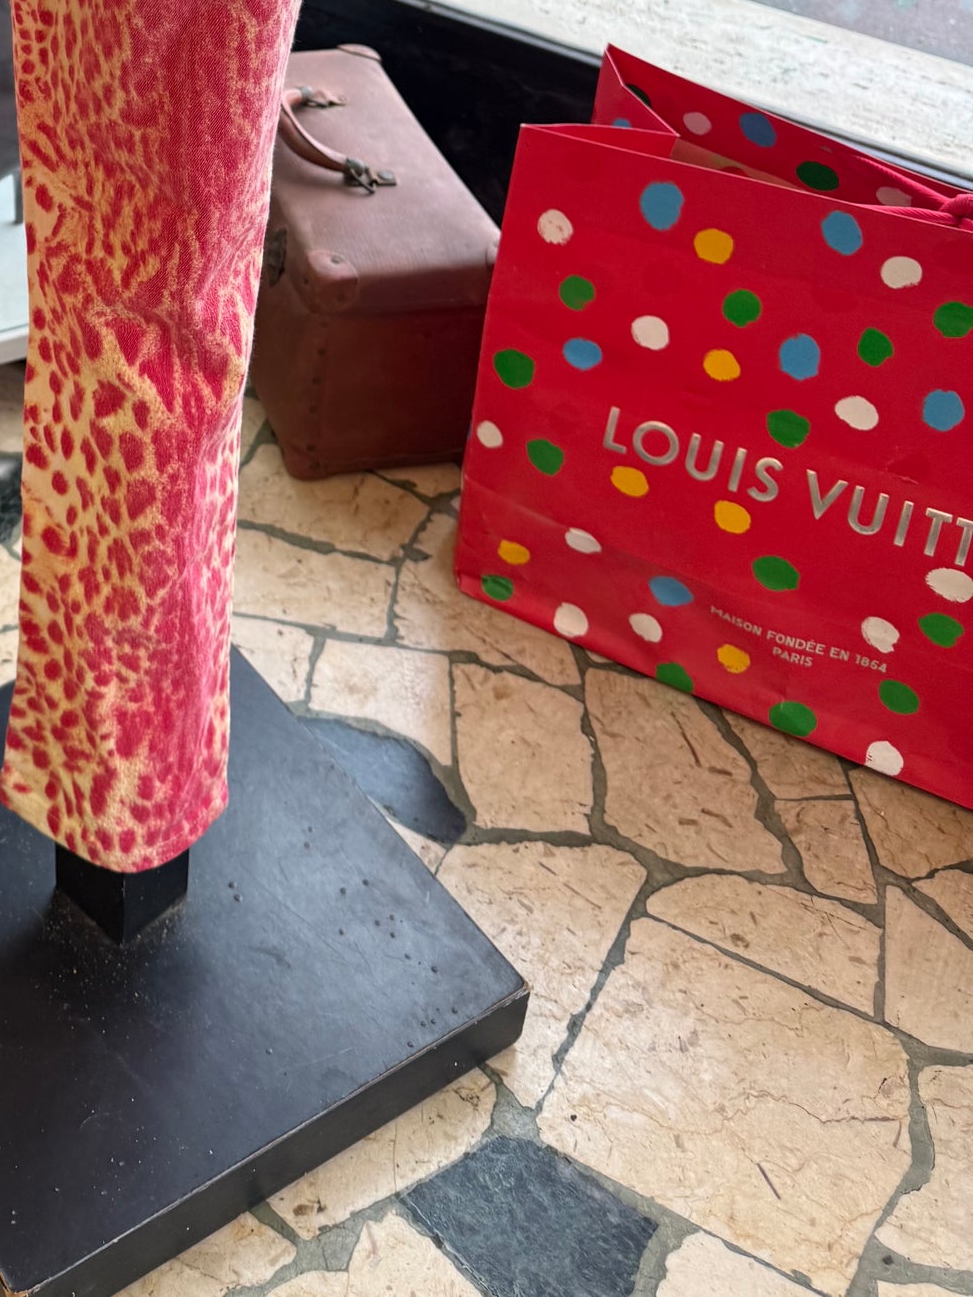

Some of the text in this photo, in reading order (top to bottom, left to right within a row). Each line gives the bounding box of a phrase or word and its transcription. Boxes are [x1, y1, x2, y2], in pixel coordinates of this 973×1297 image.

[602, 406, 784, 502] LOUIS
[710, 605, 763, 636] MAISON
[766, 629, 826, 655] FONDÉE
[829, 647, 850, 661] EN
[772, 646, 813, 667] PARIS
